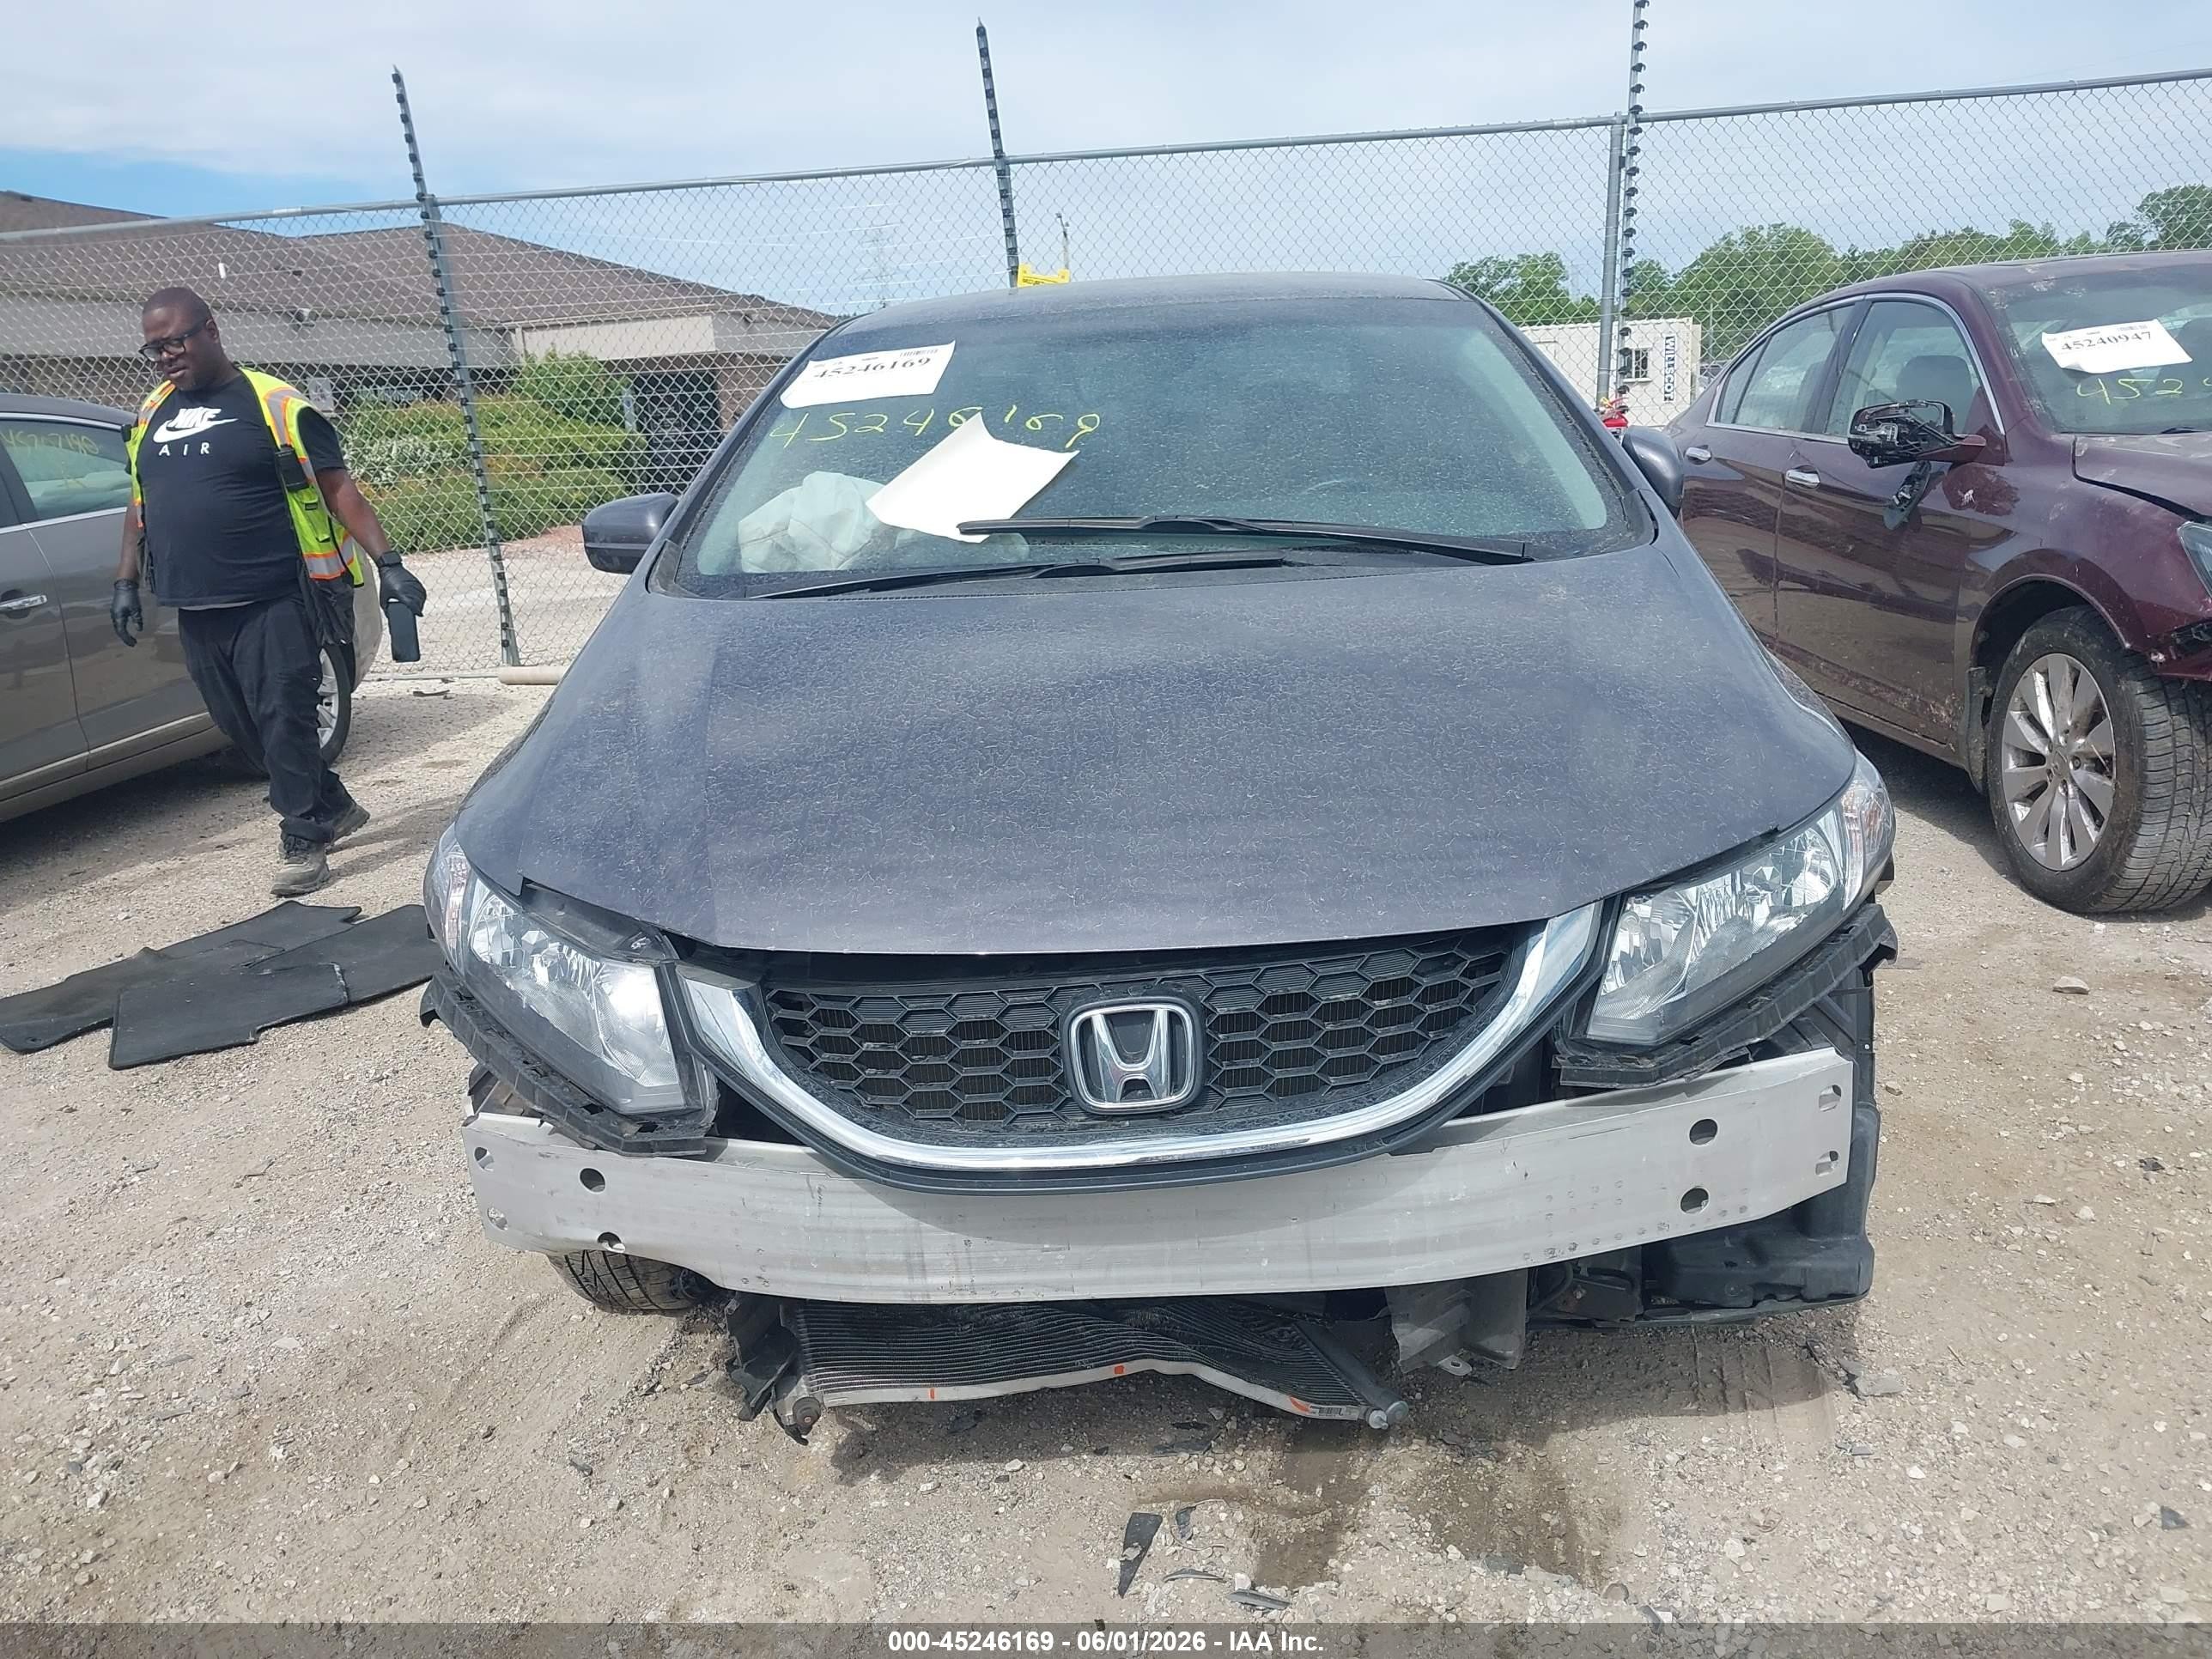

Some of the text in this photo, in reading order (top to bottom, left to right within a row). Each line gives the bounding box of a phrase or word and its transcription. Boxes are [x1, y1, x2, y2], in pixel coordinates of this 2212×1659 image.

[2061, 331, 2152, 350] 45240947
[813, 356, 931, 379] 45246169
[769, 404, 1101, 449] 45246169
